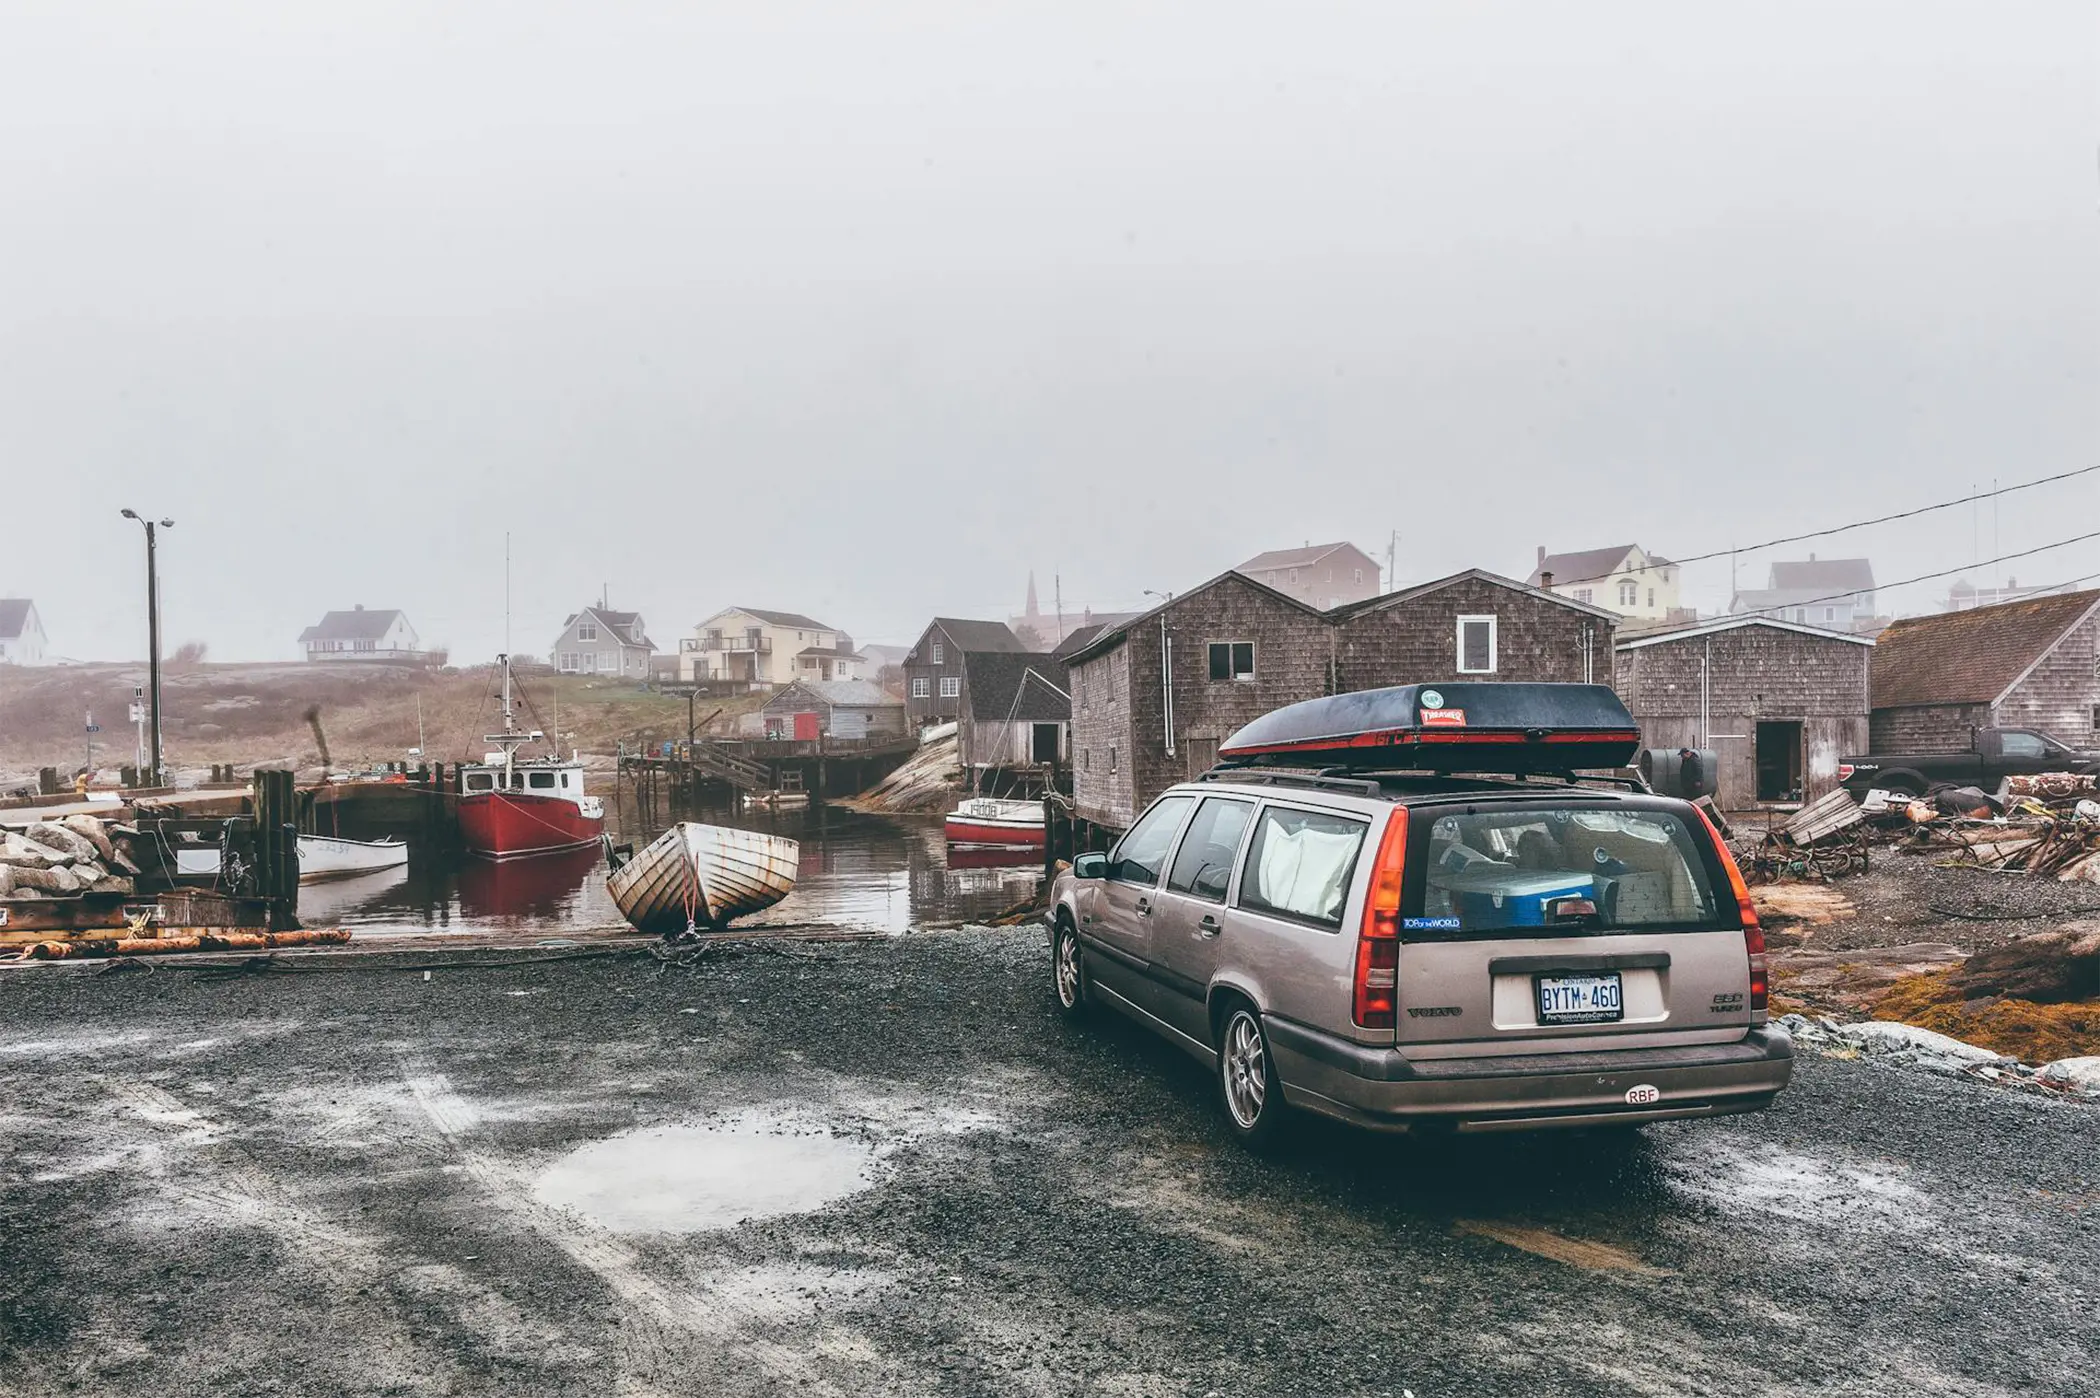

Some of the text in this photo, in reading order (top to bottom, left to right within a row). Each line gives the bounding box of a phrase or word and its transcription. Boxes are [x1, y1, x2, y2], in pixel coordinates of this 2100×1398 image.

[1423, 711, 1462, 722] THRASHER
[1404, 919, 1419, 928] TOP
[1432, 919, 1460, 928] WORLD
[1563, 978, 1596, 986] ONTARIO
[1542, 985, 1618, 1010] BYTM 460
[1407, 1007, 1462, 1017] VOLVO
[1629, 1089, 1655, 1103] RBF
